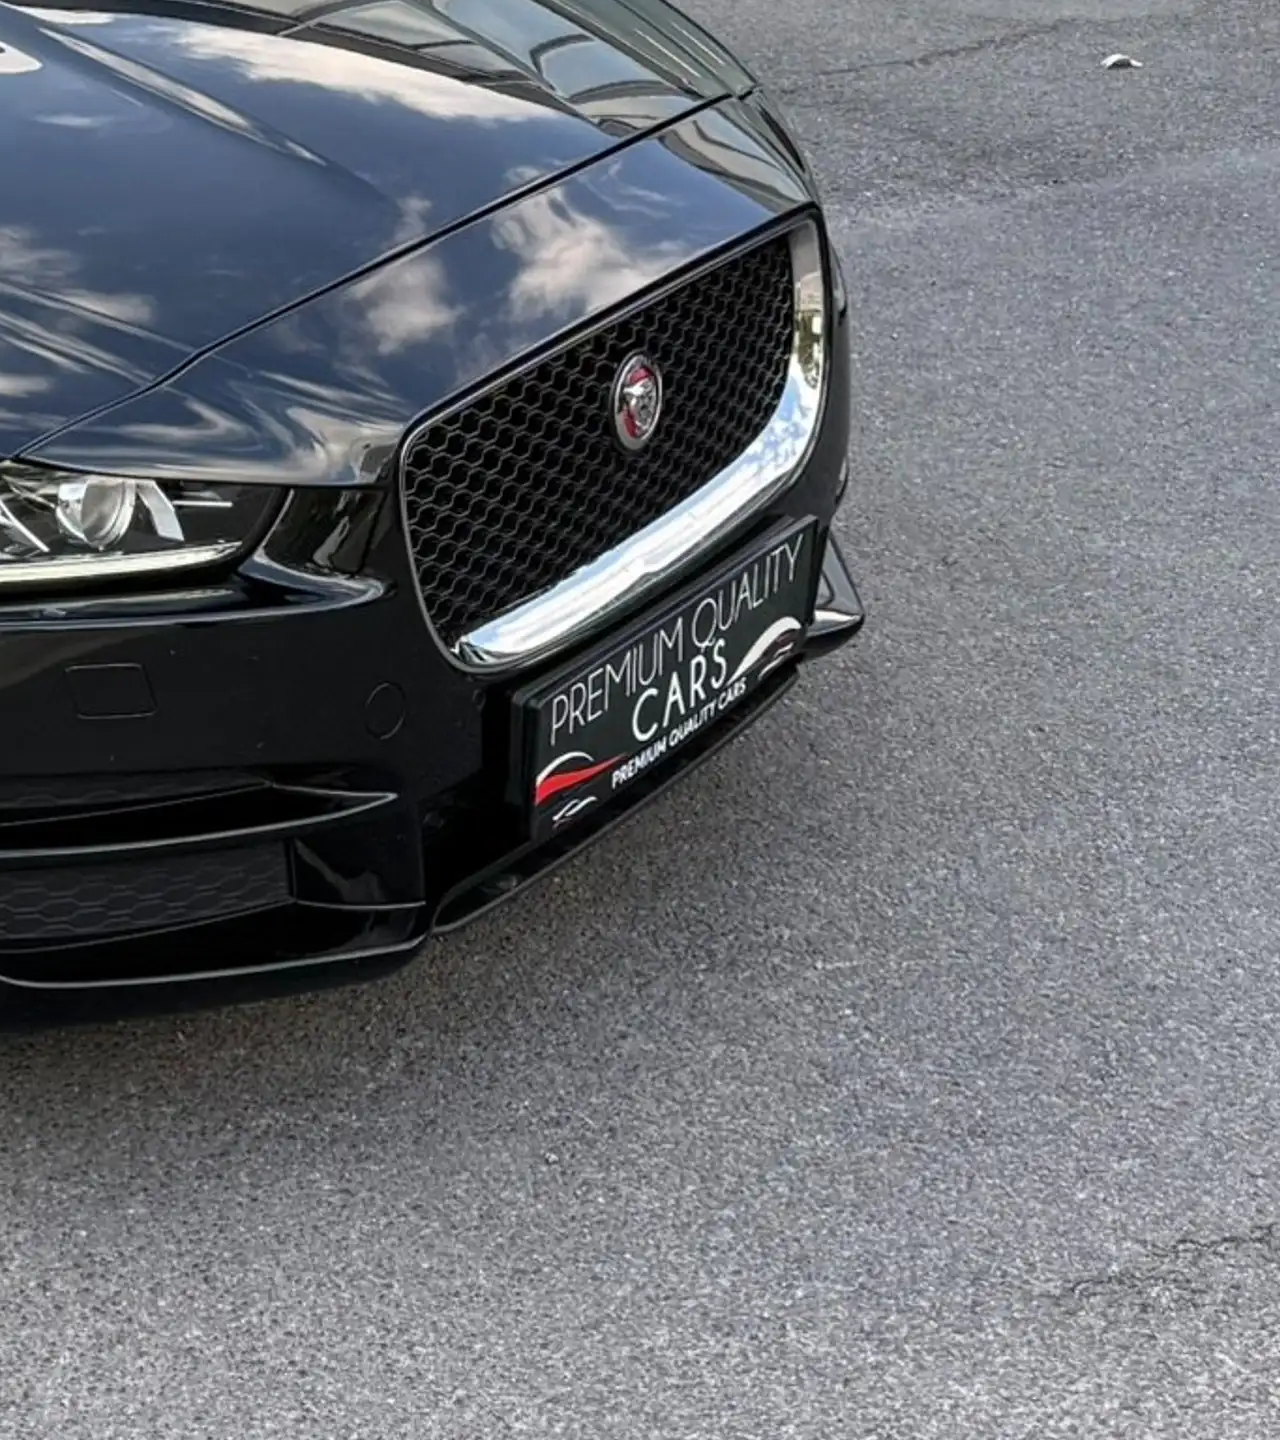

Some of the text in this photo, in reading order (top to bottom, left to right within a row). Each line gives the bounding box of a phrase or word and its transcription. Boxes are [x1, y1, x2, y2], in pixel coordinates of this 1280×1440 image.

[550, 533, 804, 746] PREMIUM QUALITY
[631, 638, 727, 742] CARS
[611, 676, 748, 789] PREMIUM QUALITY CARS
